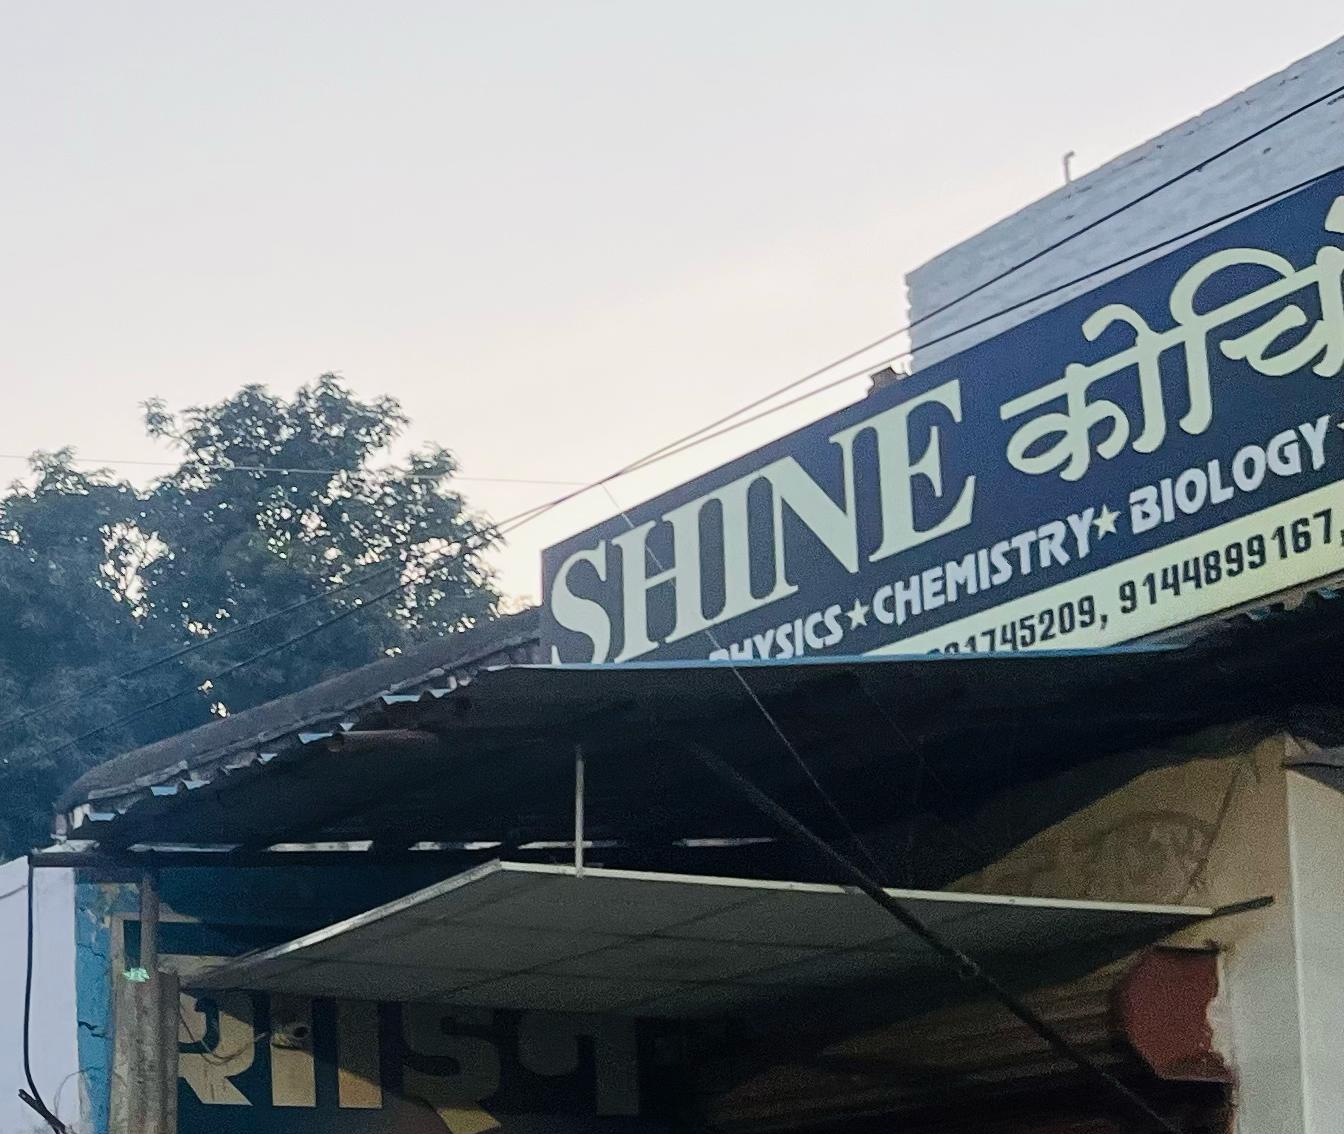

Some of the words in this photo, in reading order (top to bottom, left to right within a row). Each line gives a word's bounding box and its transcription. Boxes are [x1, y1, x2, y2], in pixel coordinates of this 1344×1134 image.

[550, 379, 978, 665] SHINE
[872, 506, 1094, 625] CHEMISTRY
[1129, 414, 1330, 535] BIOLOGY
